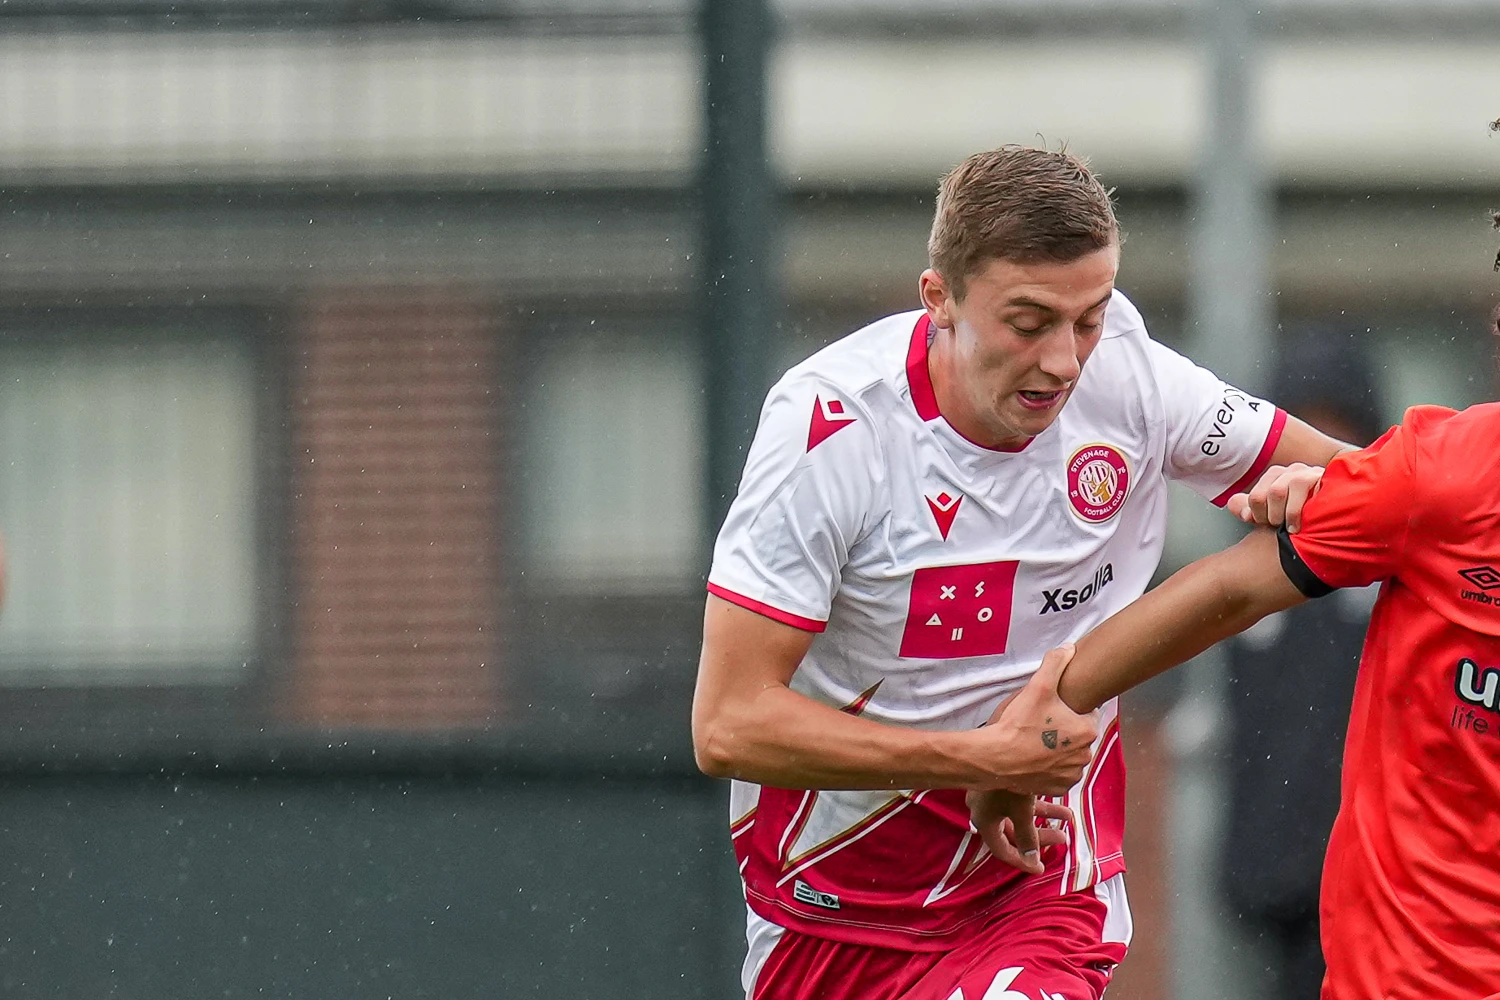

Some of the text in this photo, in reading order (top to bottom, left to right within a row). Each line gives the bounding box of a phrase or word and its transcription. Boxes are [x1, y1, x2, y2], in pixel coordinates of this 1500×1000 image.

[1071, 449, 1110, 473] STEVENAGE
[1083, 490, 1124, 516] FOOTBALL CLUB
[1039, 562, 1114, 616] Xsolla
[1450, 705, 1489, 734] life
